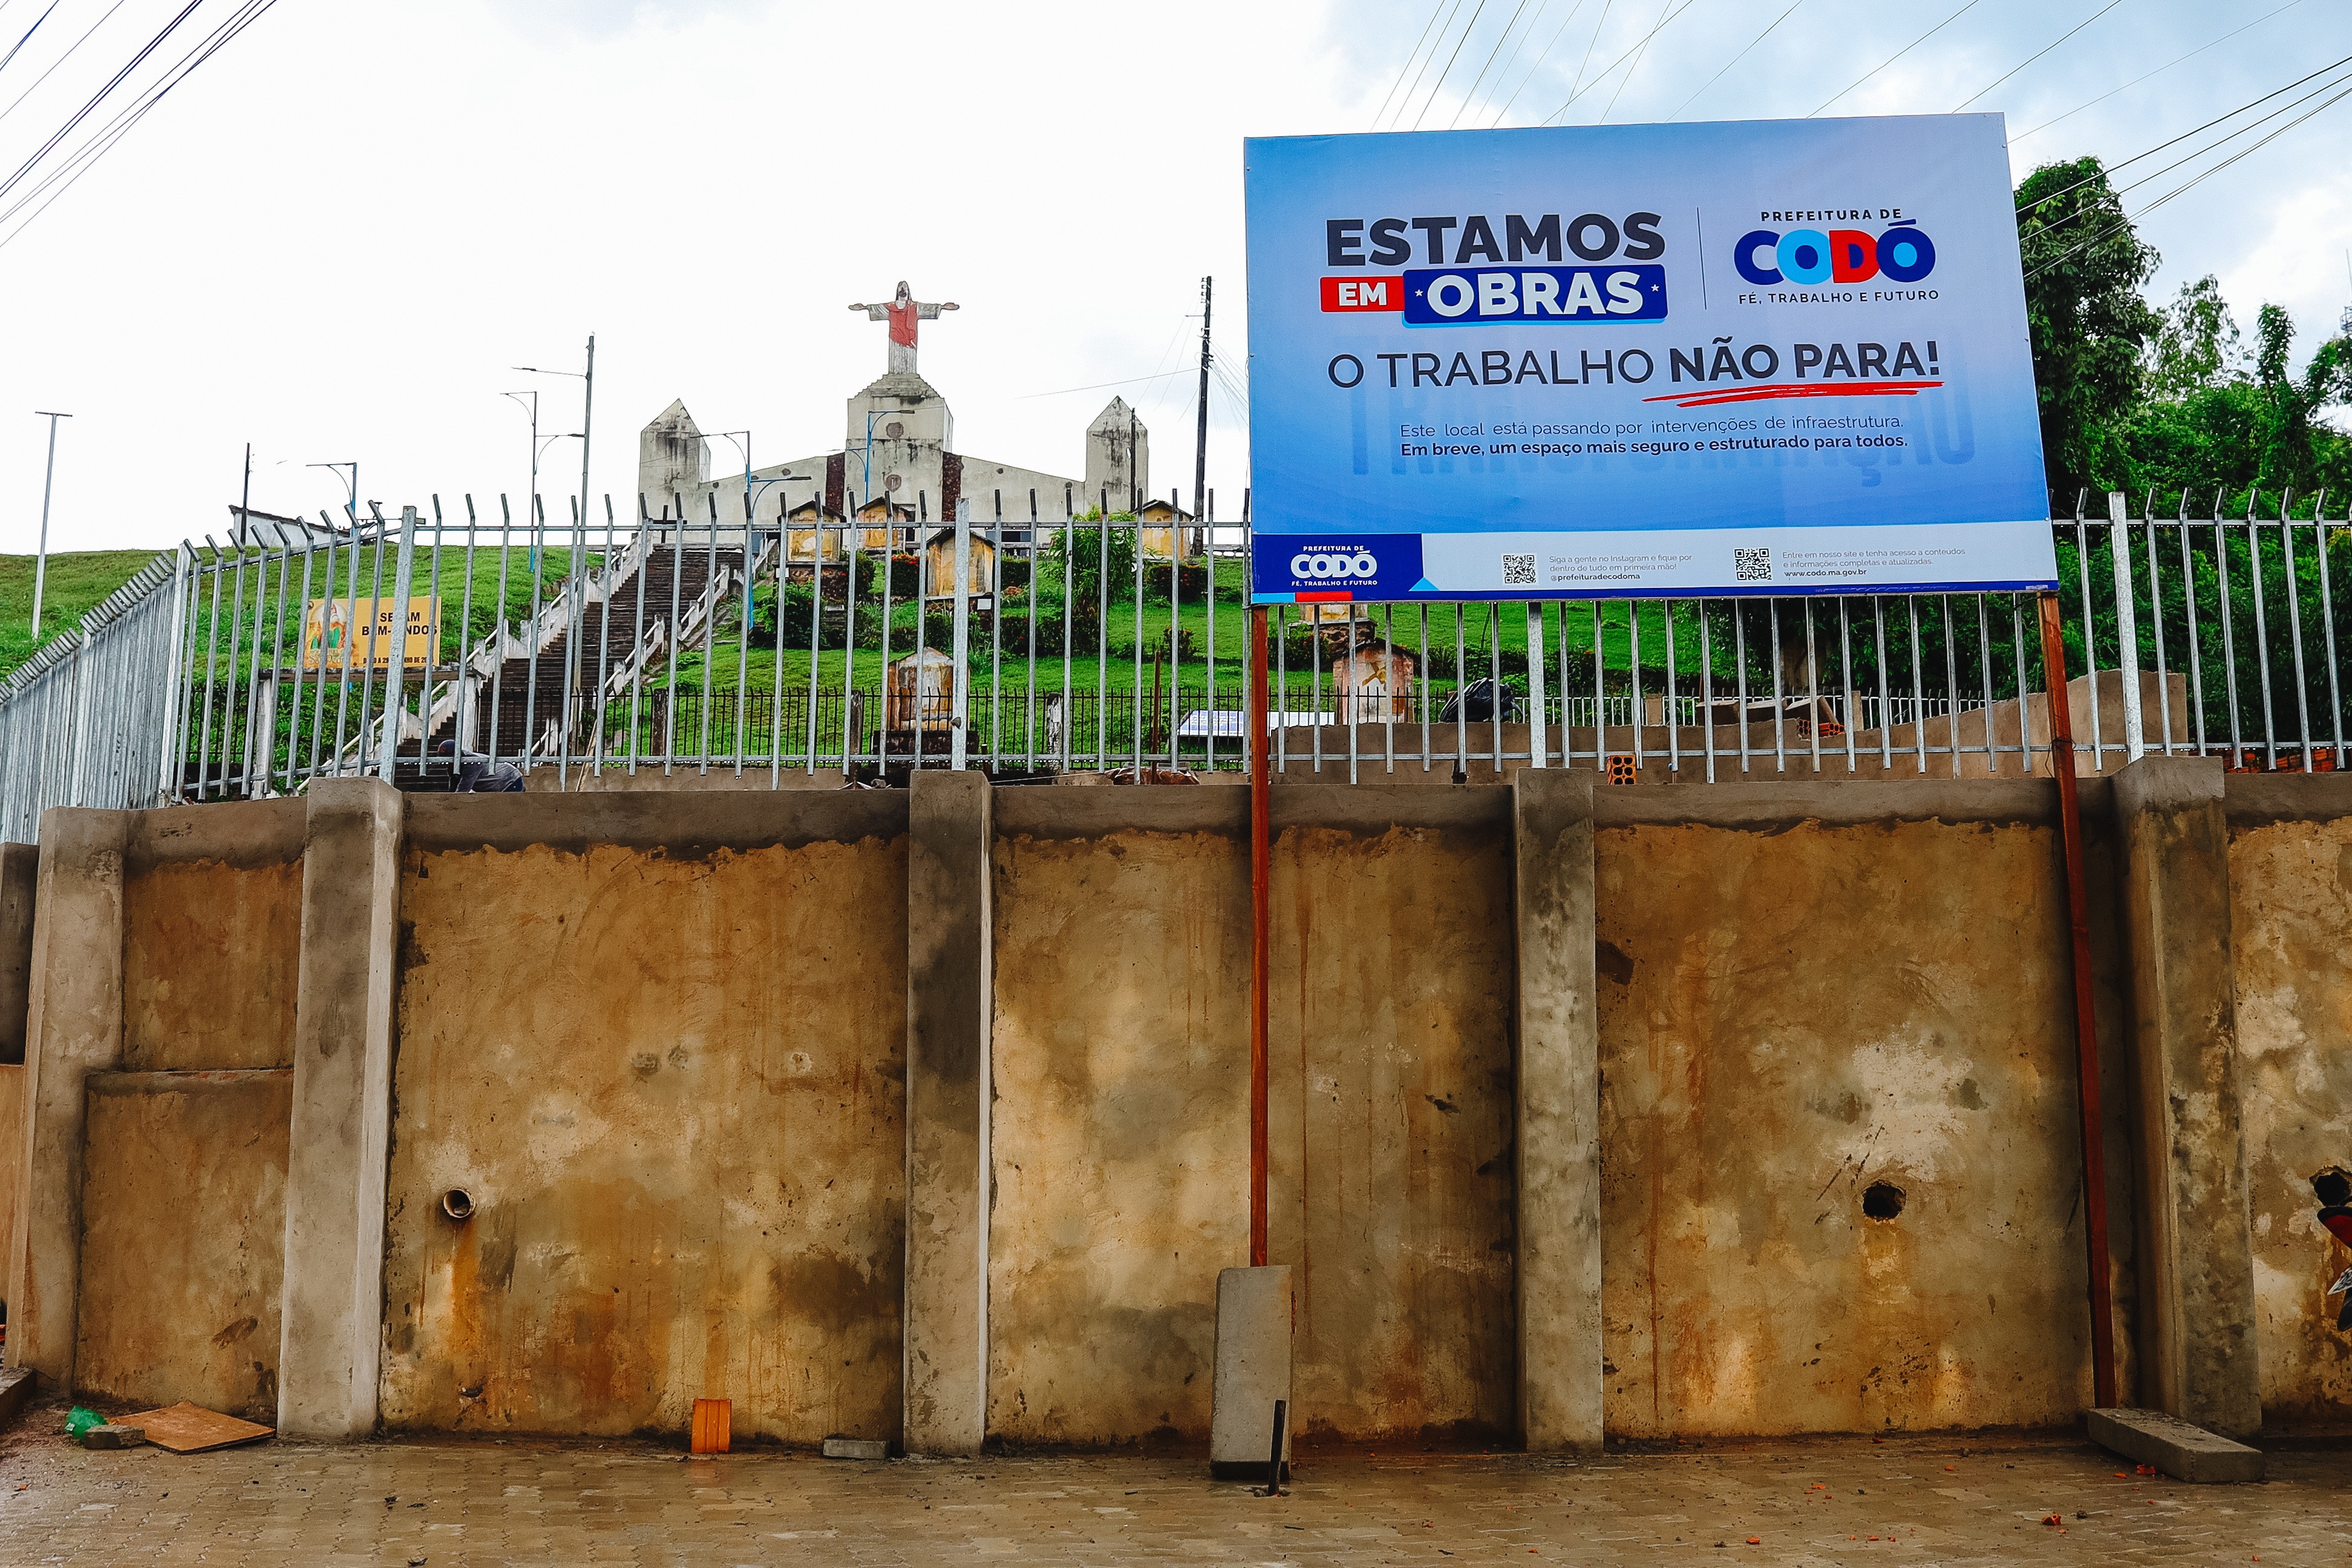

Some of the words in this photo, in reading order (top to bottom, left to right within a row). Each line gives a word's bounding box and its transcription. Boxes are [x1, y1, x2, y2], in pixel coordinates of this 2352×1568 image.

[1761, 209, 1872, 221] PREFEITURA
[1880, 209, 1902, 219] DE
[1326, 212, 1666, 266] ESTAMOS
[1734, 218, 1936, 286] CODÓ
[1338, 282, 1387, 306] EM
[1427, 272, 1643, 316] OBRAS
[1739, 292, 1762, 305] FÉ,
[1768, 292, 1852, 304] TRABALHO
[1860, 292, 1868, 302] E
[1875, 290, 1939, 301] FUTURO
[1328, 354, 1364, 388] O
[1376, 349, 1654, 388] TRABALHO
[1670, 336, 1779, 382] NÃO
[1794, 341, 1940, 378] PARA!
[1400, 424, 1436, 437] Este
[1445, 422, 1485, 436] local
[1493, 421, 1527, 435] está
[1532, 422, 1610, 437] passando
[1616, 423, 1642, 437] por
[1651, 418, 1757, 434] intervenções
[1765, 416, 1786, 429] de
[1792, 415, 1904, 429] infraestrutura.
[1401, 443, 1428, 456] Em
[1432, 443, 1485, 457] breve,
[1489, 445, 1517, 454] um
[1521, 443, 1583, 457] espaço
[1587, 440, 1626, 453] mais
[1631, 439, 1690, 455] seguro
[1694, 440, 1705, 451] e
[1709, 436, 1809, 450] estruturado
[1814, 438, 1852, 451] para
[1855, 434, 1909, 448] todos.
[1290, 550, 1377, 578] CODÓ
[1549, 556, 1566, 564] Siga
[1610, 555, 1649, 564] Instagram
[1658, 554, 1677, 563] fique
[1790, 560, 1838, 569] informações
[1839, 559, 1880, 568] completas
[1624, 564, 1655, 573] primeira
[1784, 569, 1867, 577] www.codo.ma.gov.br
[1550, 573, 1641, 582] @prefeituradecodoma
[380, 612, 420, 622] SEM
[362, 625, 437, 635] BM-NDO
